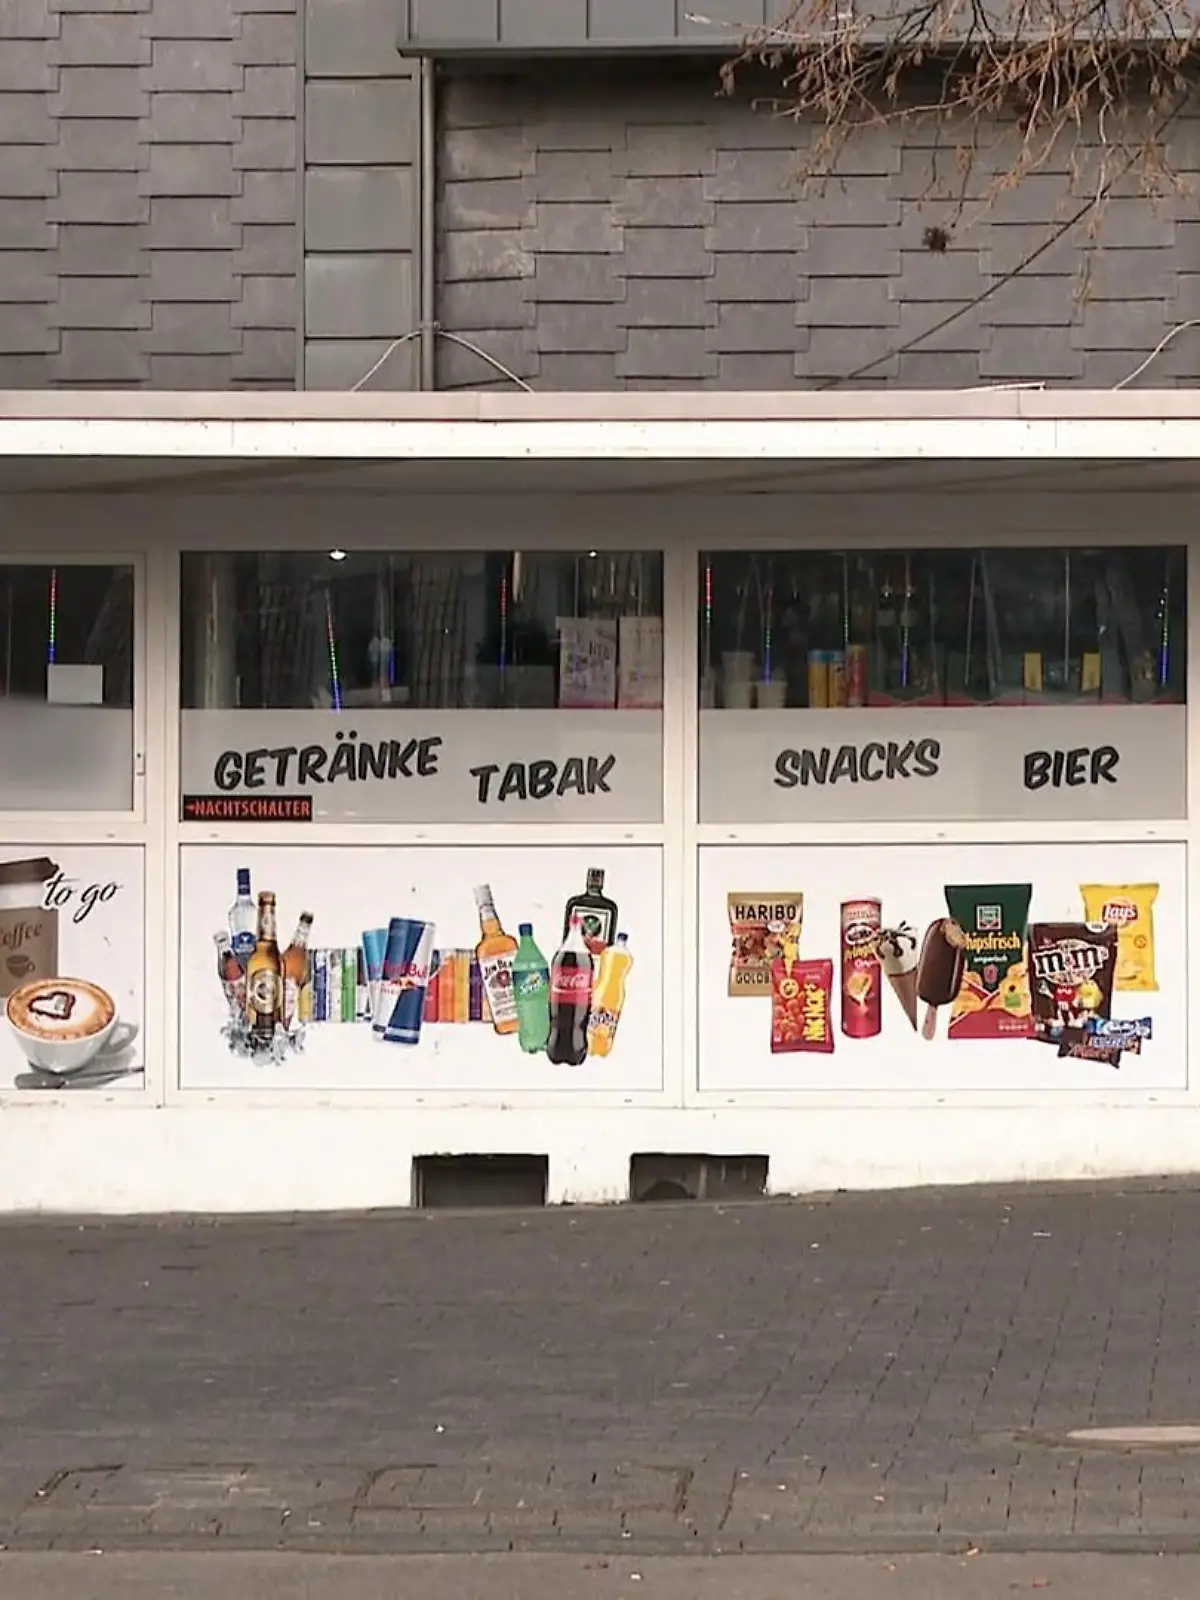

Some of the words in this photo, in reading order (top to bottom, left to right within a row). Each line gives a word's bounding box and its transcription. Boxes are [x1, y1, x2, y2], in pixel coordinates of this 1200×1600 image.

[214, 731, 443, 790] GETRÄNKE
[469, 753, 616, 804] TABAK
[774, 738, 940, 789] SNACKS
[1023, 745, 1120, 790] BIER
[193, 799, 311, 819] NACHTSCHALTER
[45, 872, 80, 906] to
[73, 881, 124, 924] go
[735, 904, 797, 921] HARIBO
[965, 931, 1021, 953] hipsfrisch
